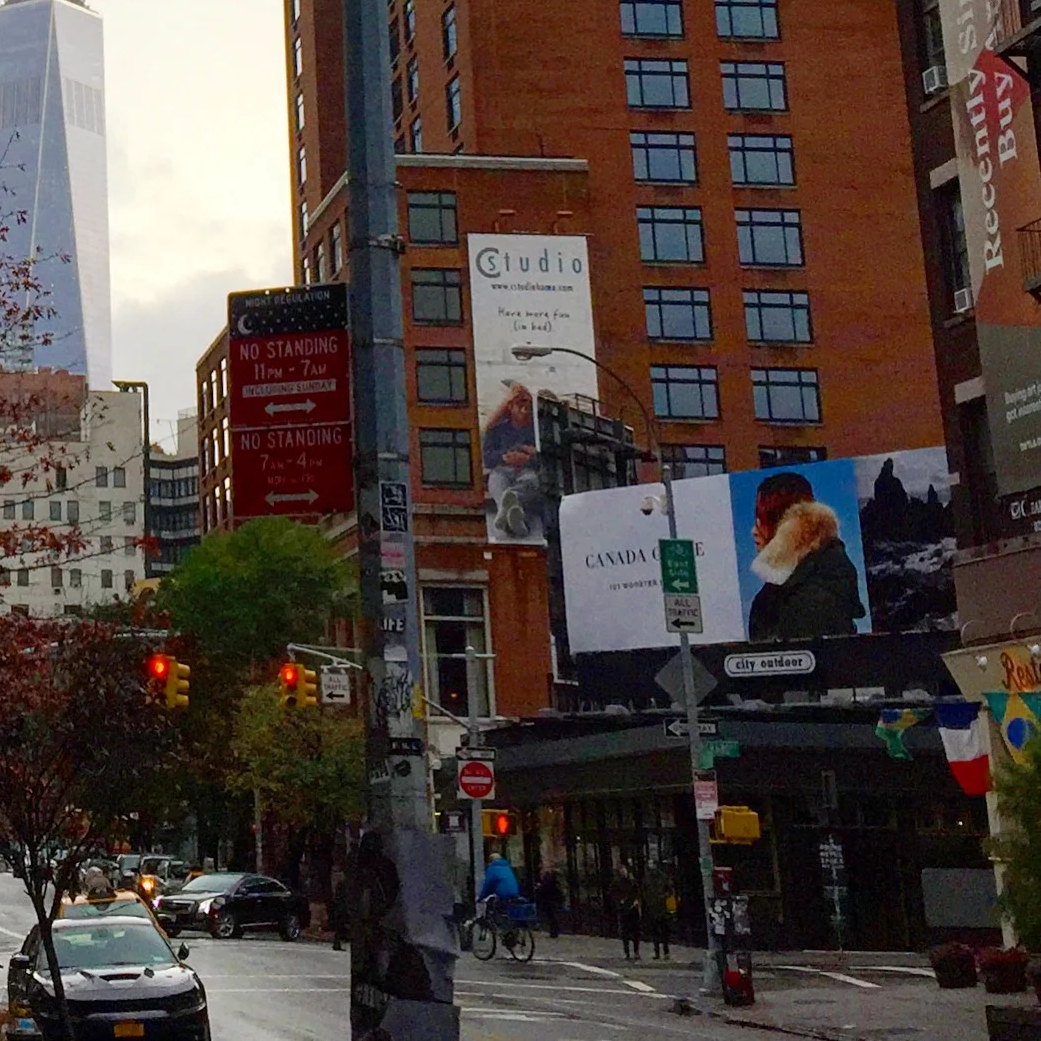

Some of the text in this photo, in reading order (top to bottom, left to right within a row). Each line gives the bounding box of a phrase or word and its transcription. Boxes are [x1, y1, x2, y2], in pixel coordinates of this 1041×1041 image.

[994, 71, 1018, 169] Buy
[966, 68, 1004, 275] Recently
[245, 290, 331, 308] NIGHT REGULATION
[498, 306, 570, 320] Have more fun
[513, 320, 552, 333] (in bed)
[239, 336, 339, 361] NO STANDING
[254, 362, 283, 381] 11PM
[300, 359, 327, 377] 7AM
[245, 380, 333, 396] INCLUDING SUNDAY
[240, 427, 343, 450] NO STANDING
[585, 548, 647, 569] CANADA
[674, 598, 692, 608] ALL
[668, 608, 699, 617] TRAFFIC
[735, 656, 804, 673] city outdoor
